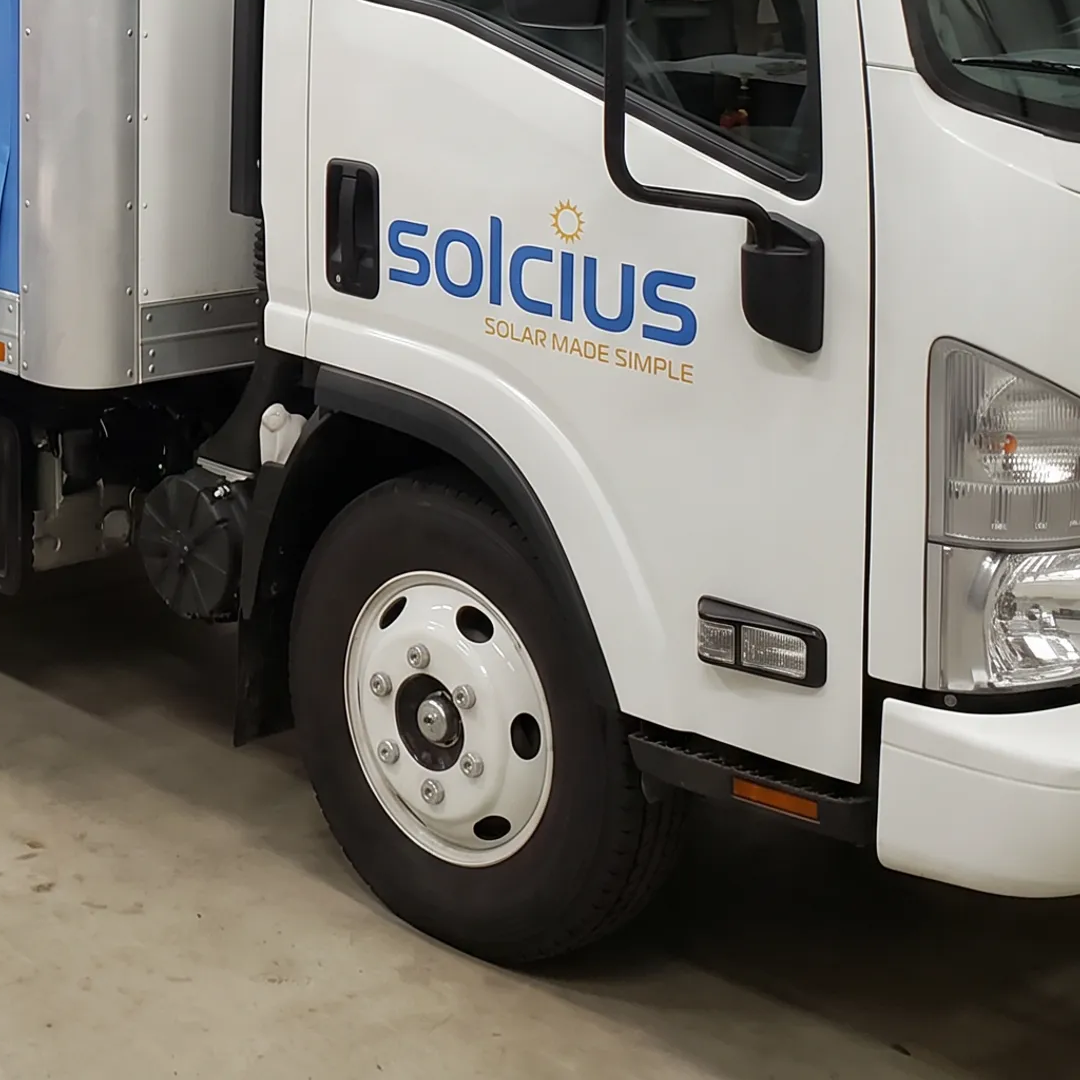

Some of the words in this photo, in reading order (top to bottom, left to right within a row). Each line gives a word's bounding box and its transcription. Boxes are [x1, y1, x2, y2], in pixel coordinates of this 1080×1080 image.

[387, 215, 698, 347] solcius
[484, 317, 547, 347] SOLAR
[552, 333, 610, 363] MADE
[615, 347, 694, 384] SIMPLE
